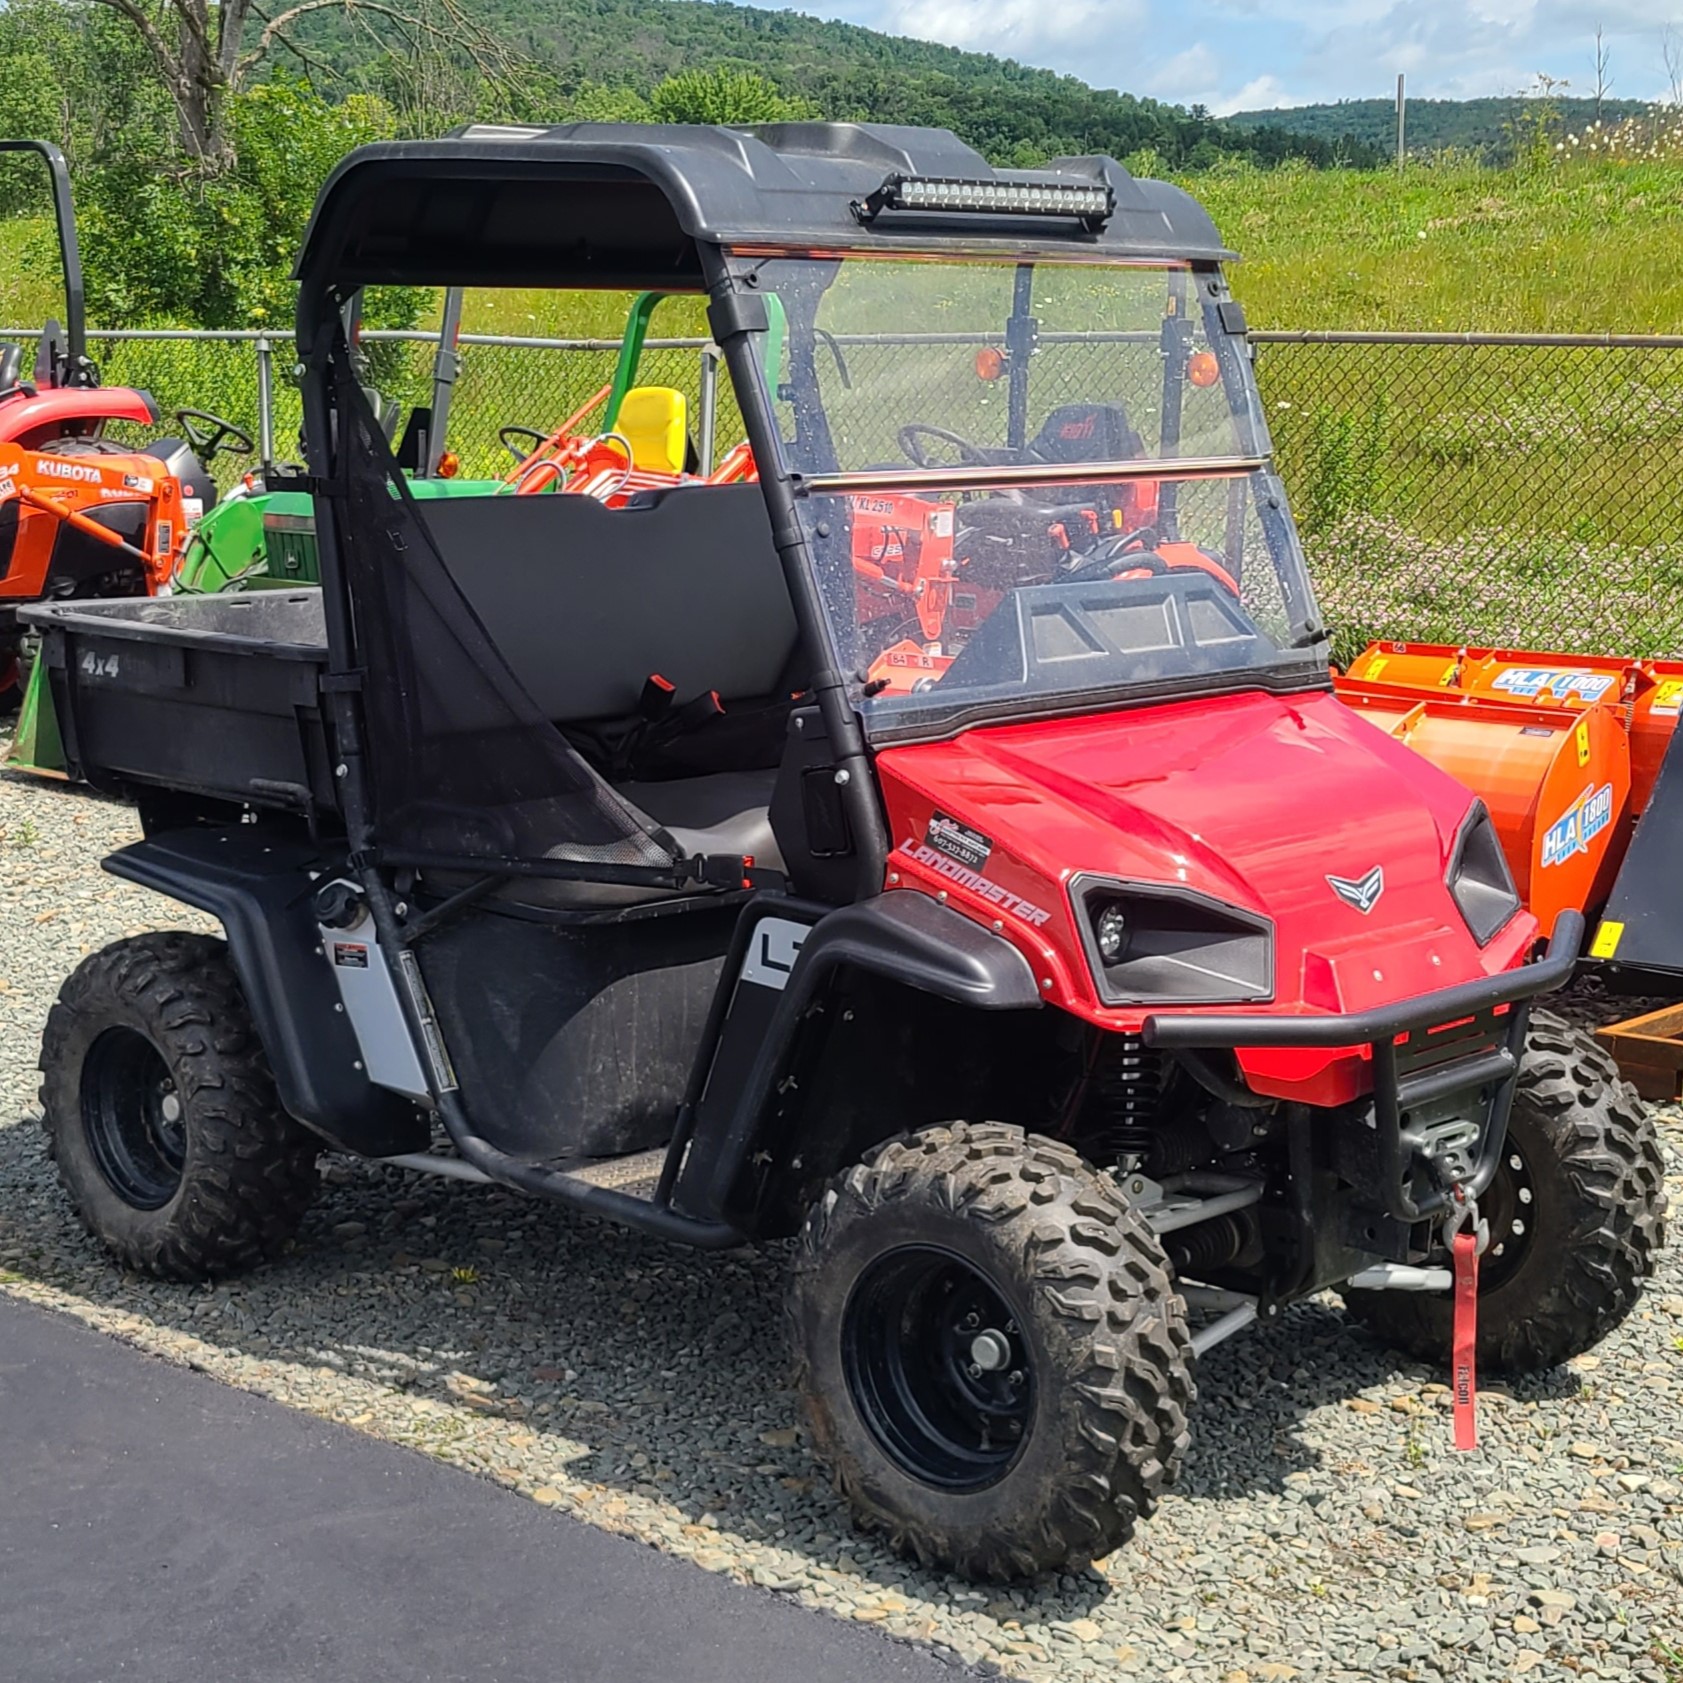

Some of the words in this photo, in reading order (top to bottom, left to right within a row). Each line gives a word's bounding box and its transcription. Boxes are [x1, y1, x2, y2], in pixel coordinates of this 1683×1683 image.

[37, 459, 102, 484] KUBOTA
[82, 651, 119, 677] 4x4
[1497, 669, 1550, 687] HLA
[1560, 675, 1613, 692] 1000
[1544, 819, 1577, 861] HLA
[1583, 787, 1611, 825] 1800
[899, 837, 1051, 927] LANDMASTER
